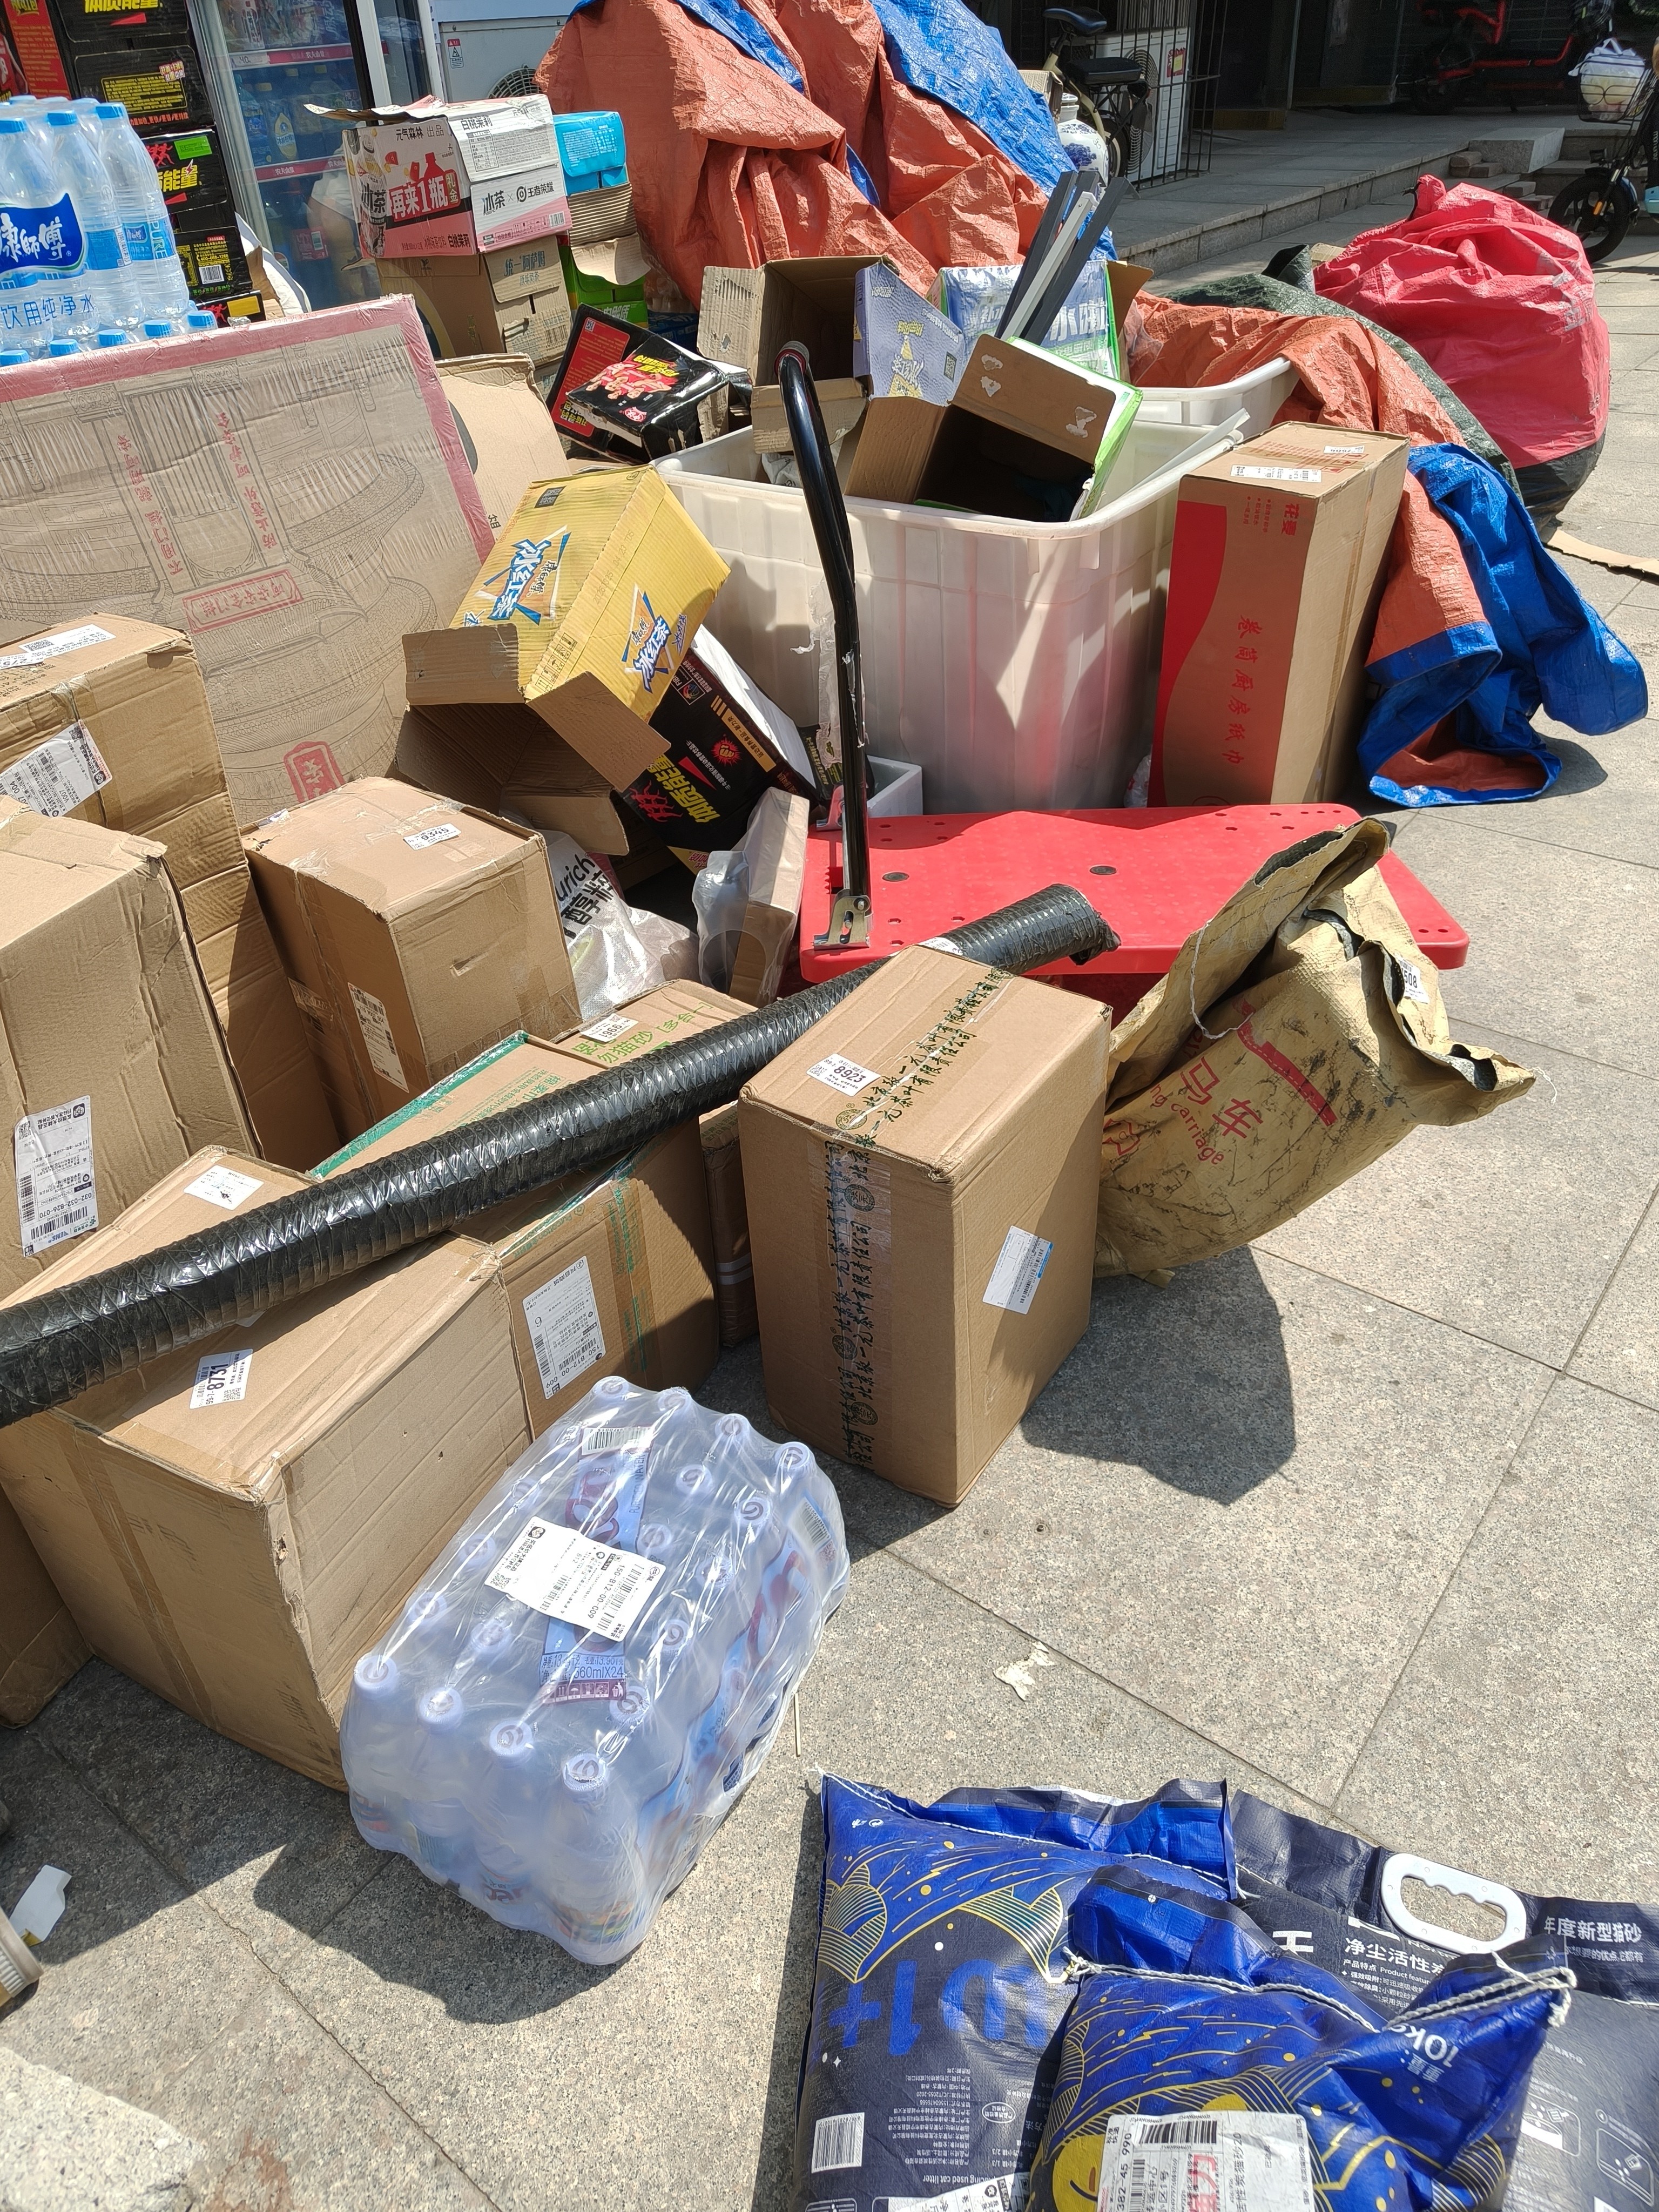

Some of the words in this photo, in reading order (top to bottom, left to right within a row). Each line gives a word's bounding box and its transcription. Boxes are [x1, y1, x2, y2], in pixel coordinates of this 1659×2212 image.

[396, 127, 424, 141] 元气森林
[427, 125, 444, 137] 出品
[461, 116, 493, 131] 白桃茉莉
[391, 176, 449, 220] 再来1瓶
[447, 172, 458, 203] 礼金
[528, 181, 555, 199] 王者荣耀
[1, 294, 95, 329] 饮用纯净水
[1220, 615, 1264, 766] 卷筒厨房纸巾
[833, 1066, 866, 1083] 8923
[1171, 1102, 1225, 1165] carriage
[39, 1192, 92, 1218] 032-032-B26-070
[206, 1363, 228, 1392] 8731
[1544, 1916, 1642, 1944] 年度新型猫砂
[1343, 1959, 1377, 1972] 产品特点
[1380, 1966, 1408, 1979] Product
[1122, 2133, 1132, 2155] 990
